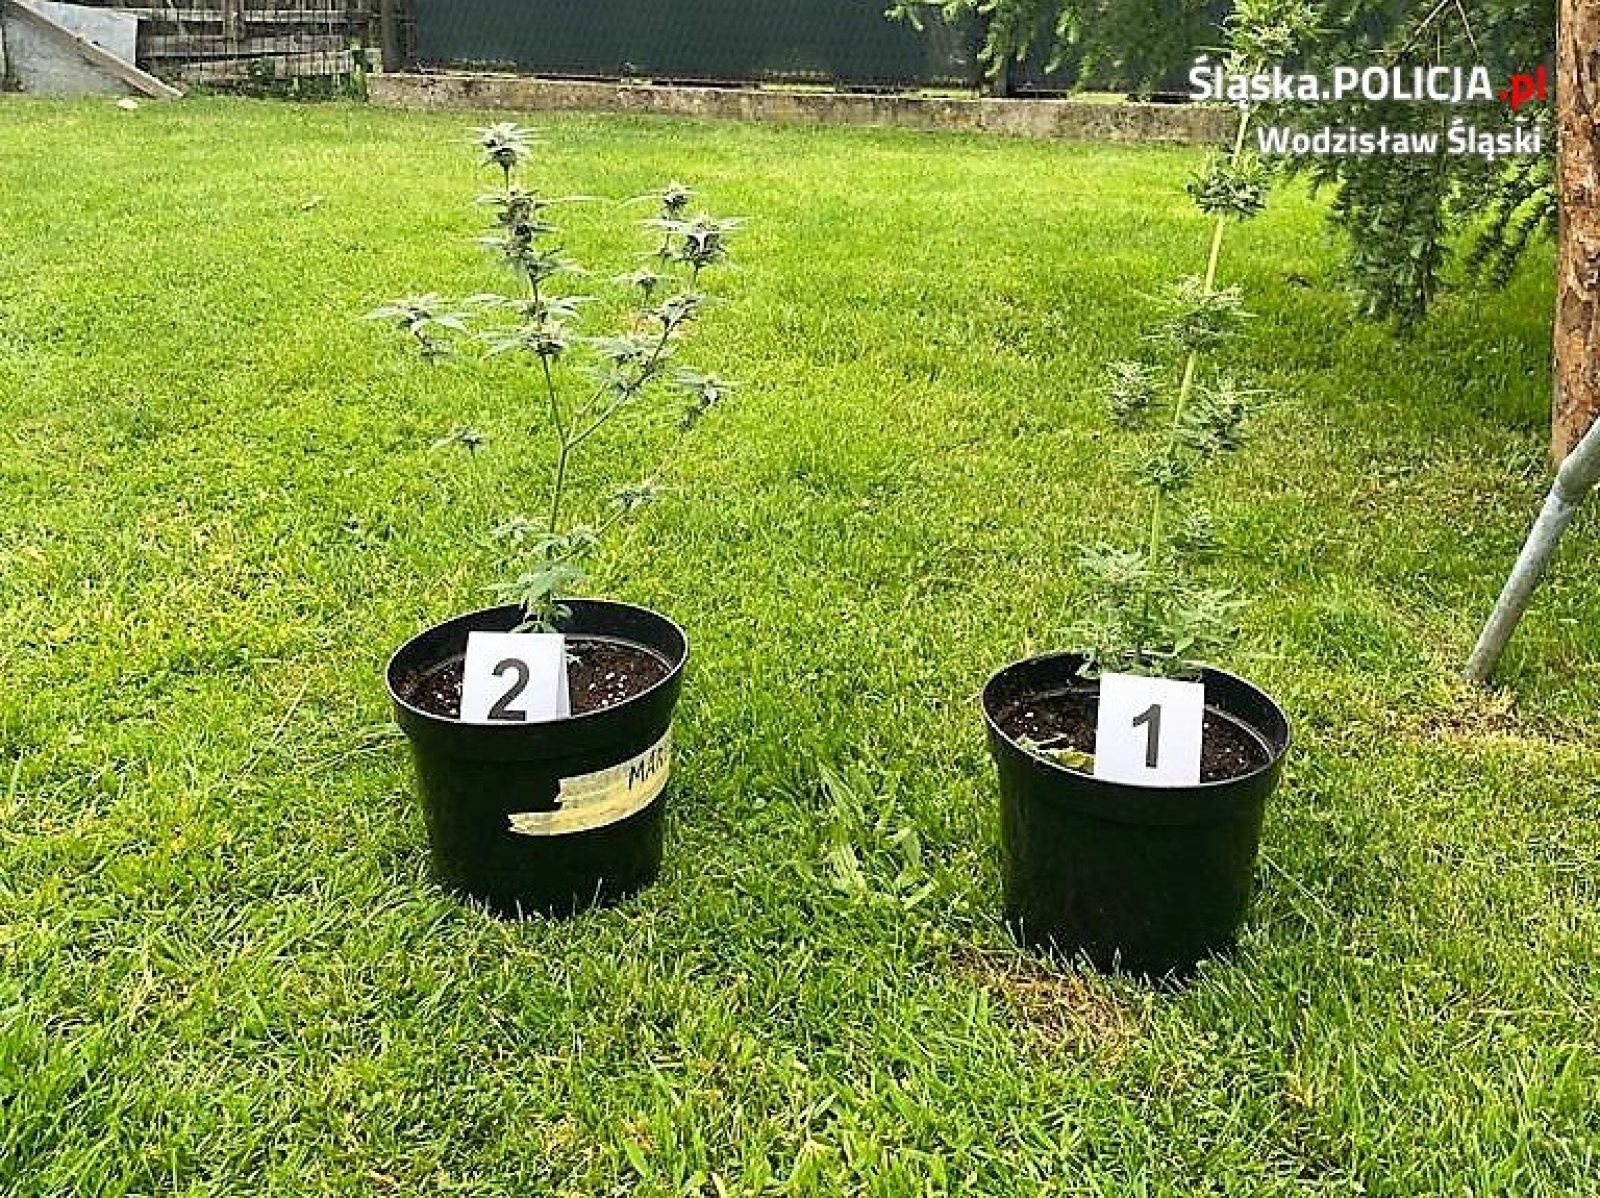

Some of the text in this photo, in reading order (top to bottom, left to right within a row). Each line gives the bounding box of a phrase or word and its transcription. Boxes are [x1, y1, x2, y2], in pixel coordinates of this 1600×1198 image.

[487, 657, 530, 721] 2
[1132, 703, 1161, 768] 1
[628, 746, 668, 790] MAR
